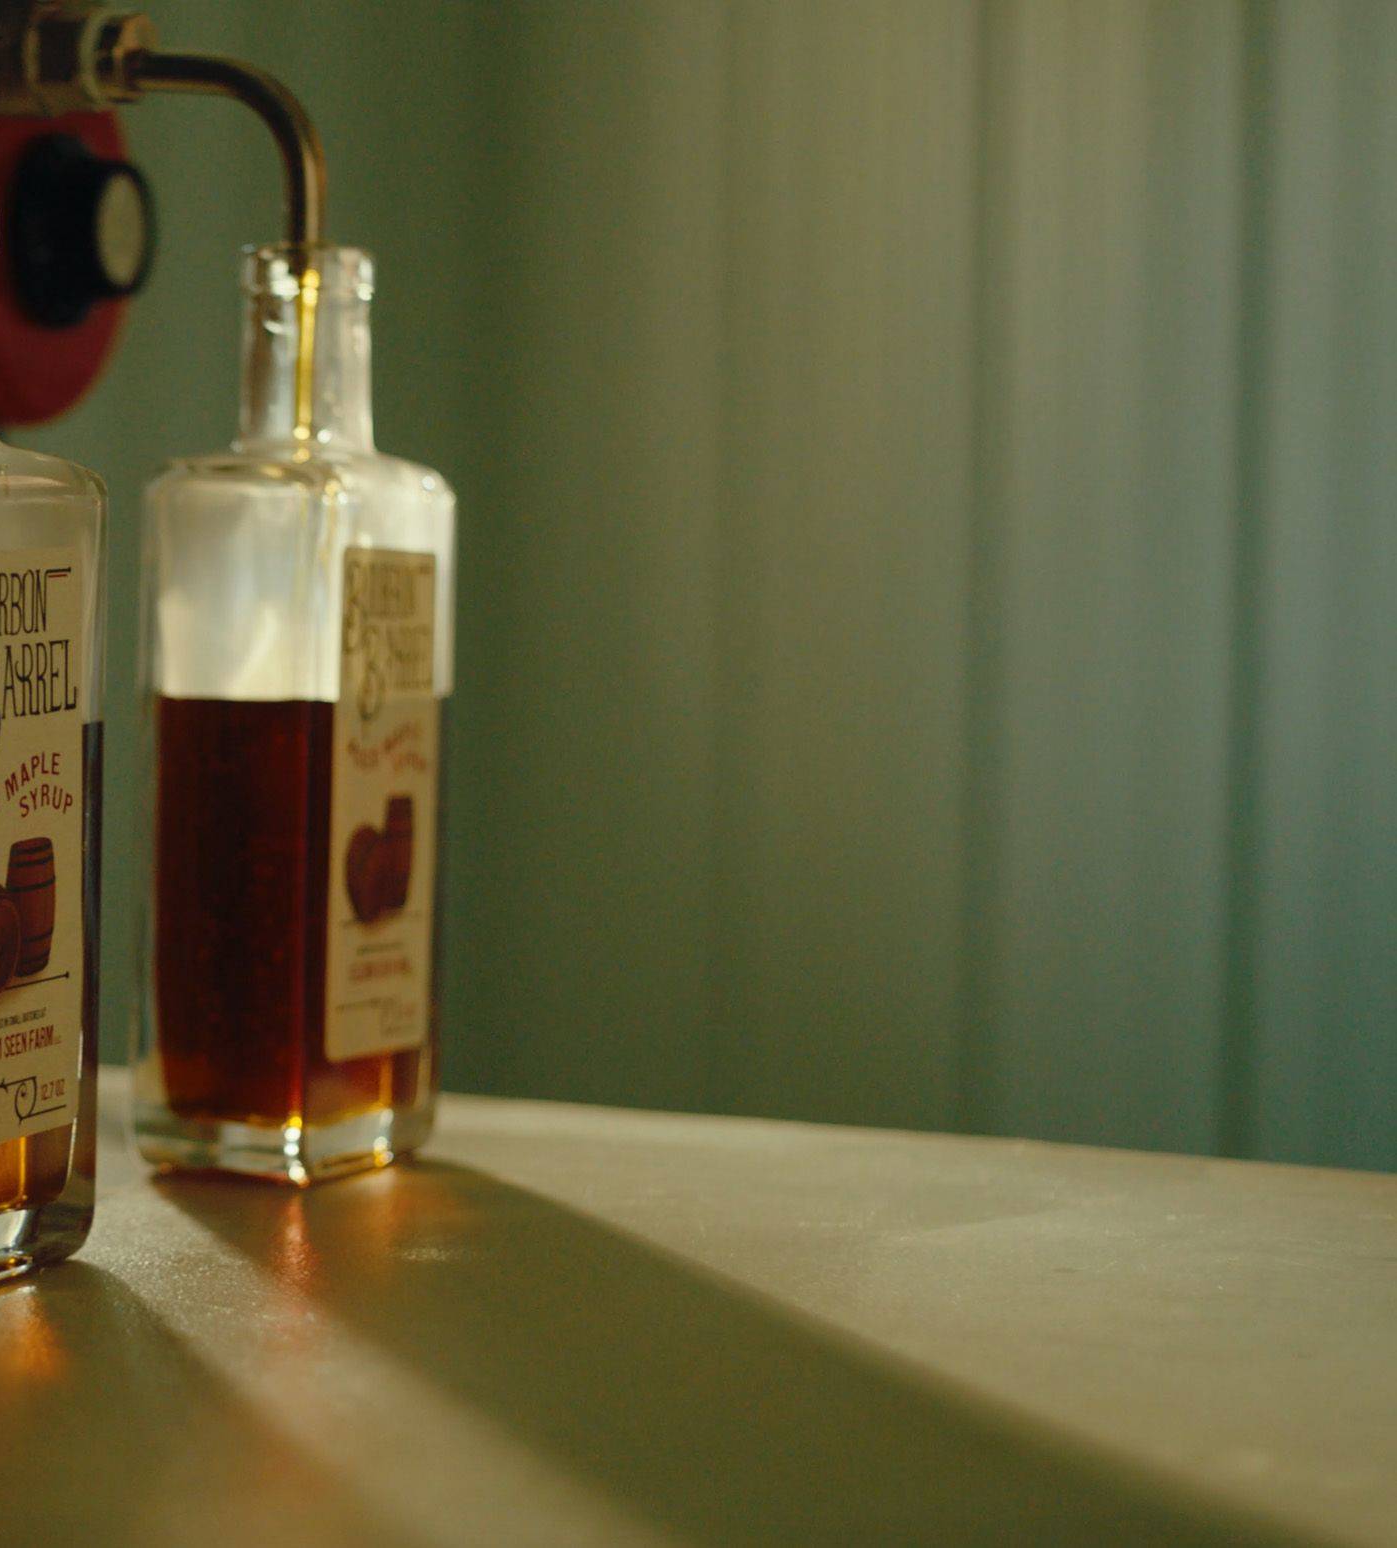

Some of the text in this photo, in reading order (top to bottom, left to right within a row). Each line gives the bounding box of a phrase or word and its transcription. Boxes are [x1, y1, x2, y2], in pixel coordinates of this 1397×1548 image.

[5, 752, 60, 801] MAPLE
[19, 783, 73, 818] SYRUP
[4, 1031, 27, 1058] SEEN
[28, 1024, 54, 1052] FARM
